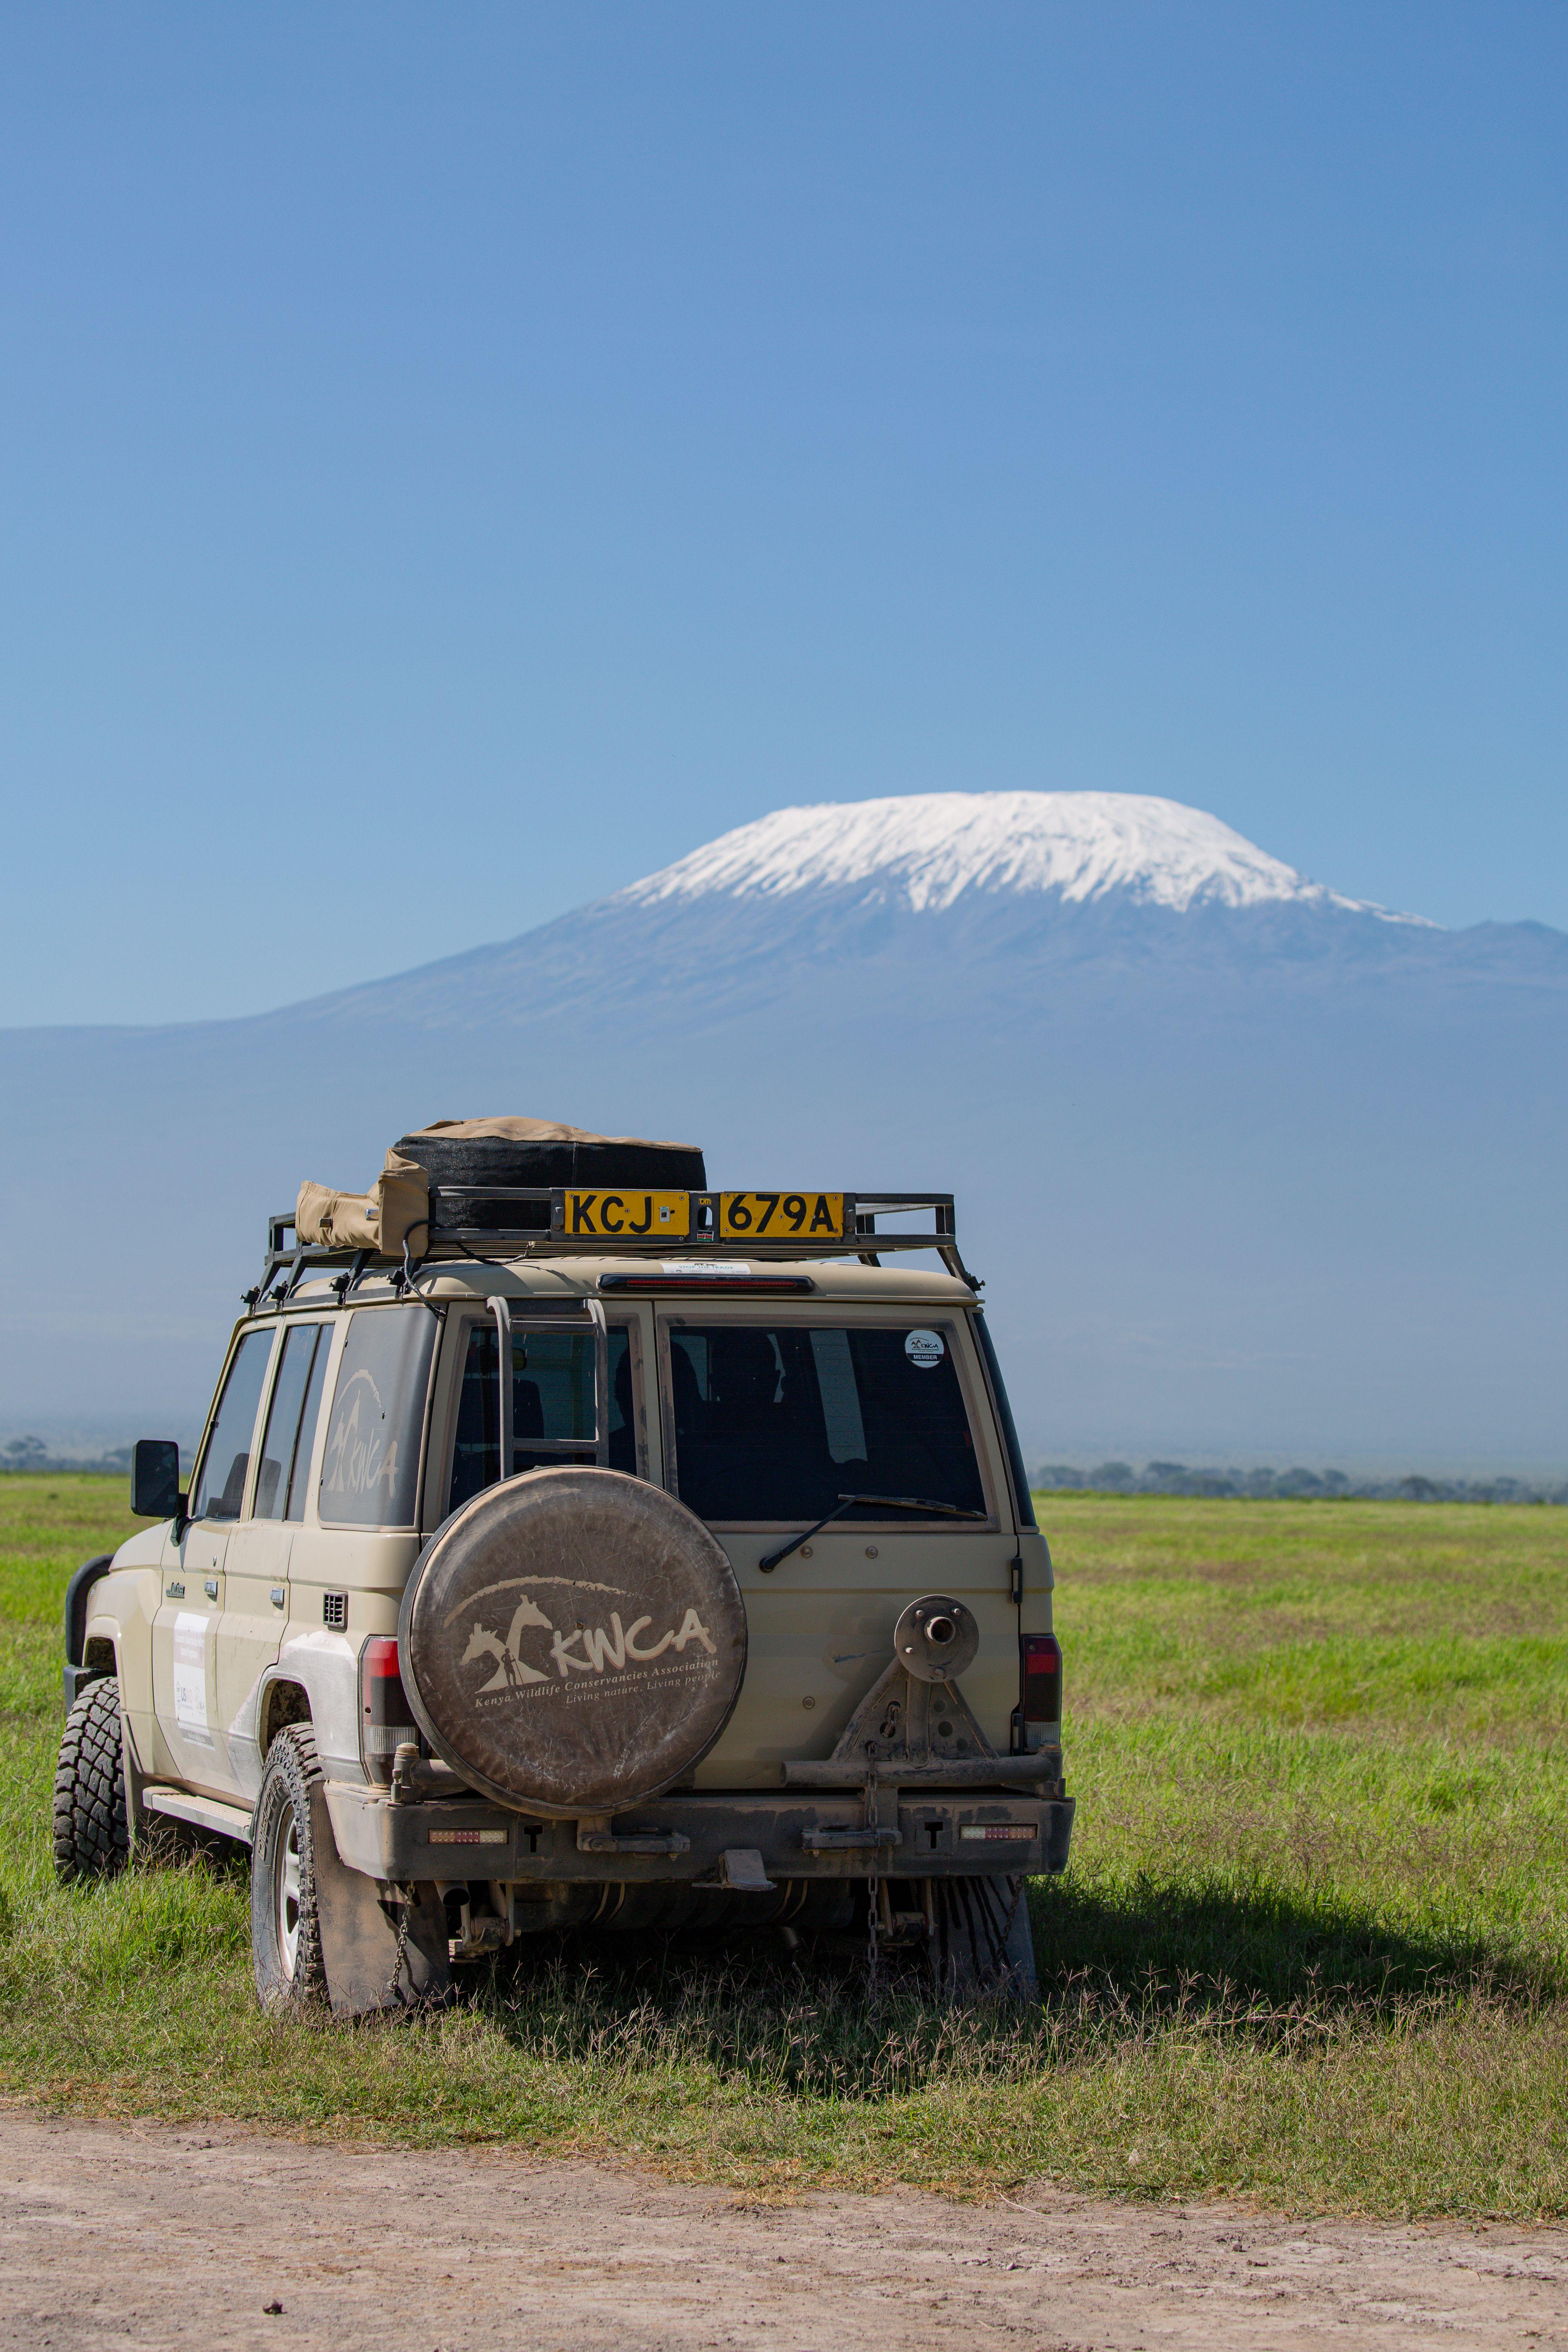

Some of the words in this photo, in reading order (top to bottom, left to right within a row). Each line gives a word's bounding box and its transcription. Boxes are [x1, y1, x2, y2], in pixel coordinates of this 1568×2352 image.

[572, 1195, 652, 1234] KCJ
[728, 1194, 834, 1233] 679A
[550, 1608, 717, 1677] KWCA
[475, 1695, 511, 1708] Kenya
[515, 1684, 560, 1700] Wildlife
[565, 1671, 648, 1691] Conservancies
[651, 1658, 719, 1677] Association
[566, 1692, 600, 1704] Living
[604, 1685, 643, 1697] nature,
[646, 1678, 681, 1690] Living
[685, 1670, 721, 1686] people
